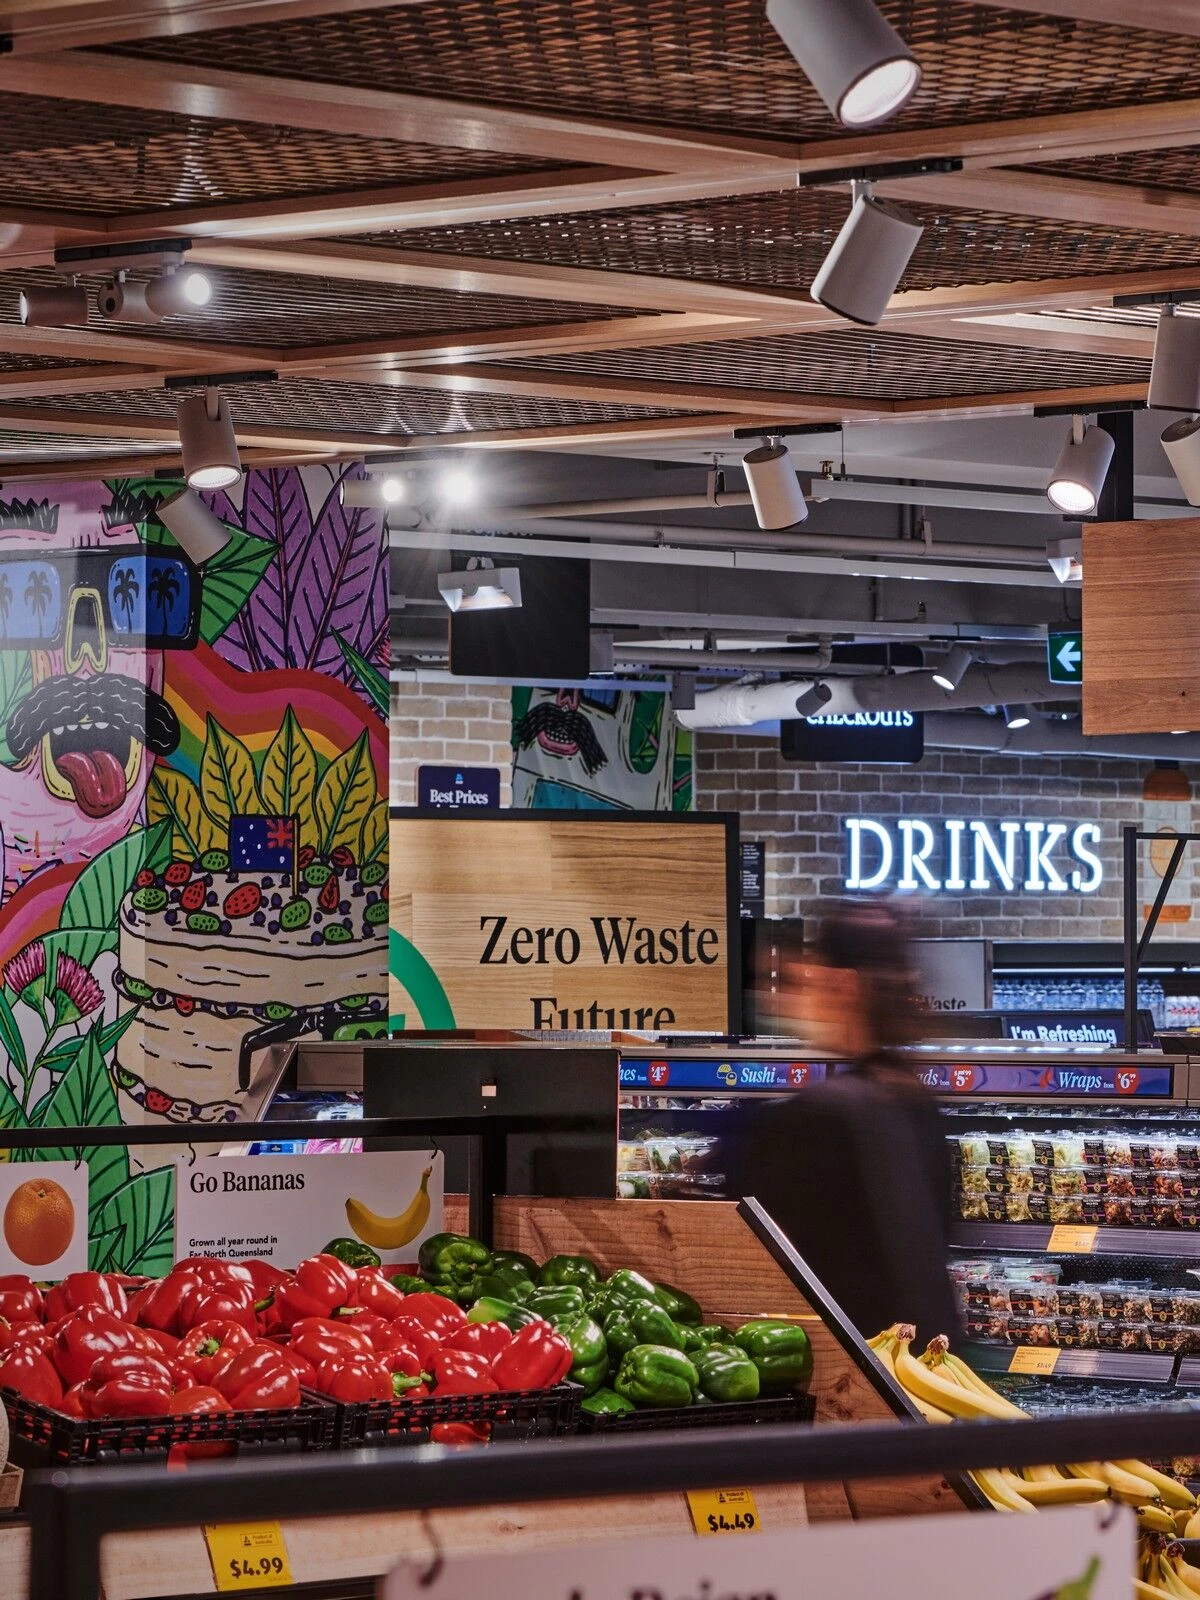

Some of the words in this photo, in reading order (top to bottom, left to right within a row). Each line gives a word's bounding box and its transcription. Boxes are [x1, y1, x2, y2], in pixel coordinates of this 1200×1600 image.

[430, 788, 454, 803] Best
[455, 789, 489, 805] Prices
[845, 818, 1104, 893] DRINKS
[479, 916, 581, 965] Zero
[590, 916, 719, 965] Waste
[529, 997, 676, 1030] Future
[1011, 1025, 1035, 1039] I'm
[1037, 1025, 1117, 1044] Refreshing
[740, 1067, 776, 1084] Sushi
[1058, 1071, 1102, 1092] Wraps
[190, 1172, 218, 1193] Go
[222, 1171, 305, 1192] Bananas
[189, 1238, 215, 1247] Grown
[217, 1237, 226, 1246] all
[228, 1237, 244, 1249] year
[246, 1236, 268, 1245] round
[270, 1236, 278, 1244] in
[203, 1249, 227, 1258] North
[229, 1248, 273, 1258] Queensland
[708, 1512, 755, 1532] $4.49
[230, 1557, 283, 1579] $4.99
